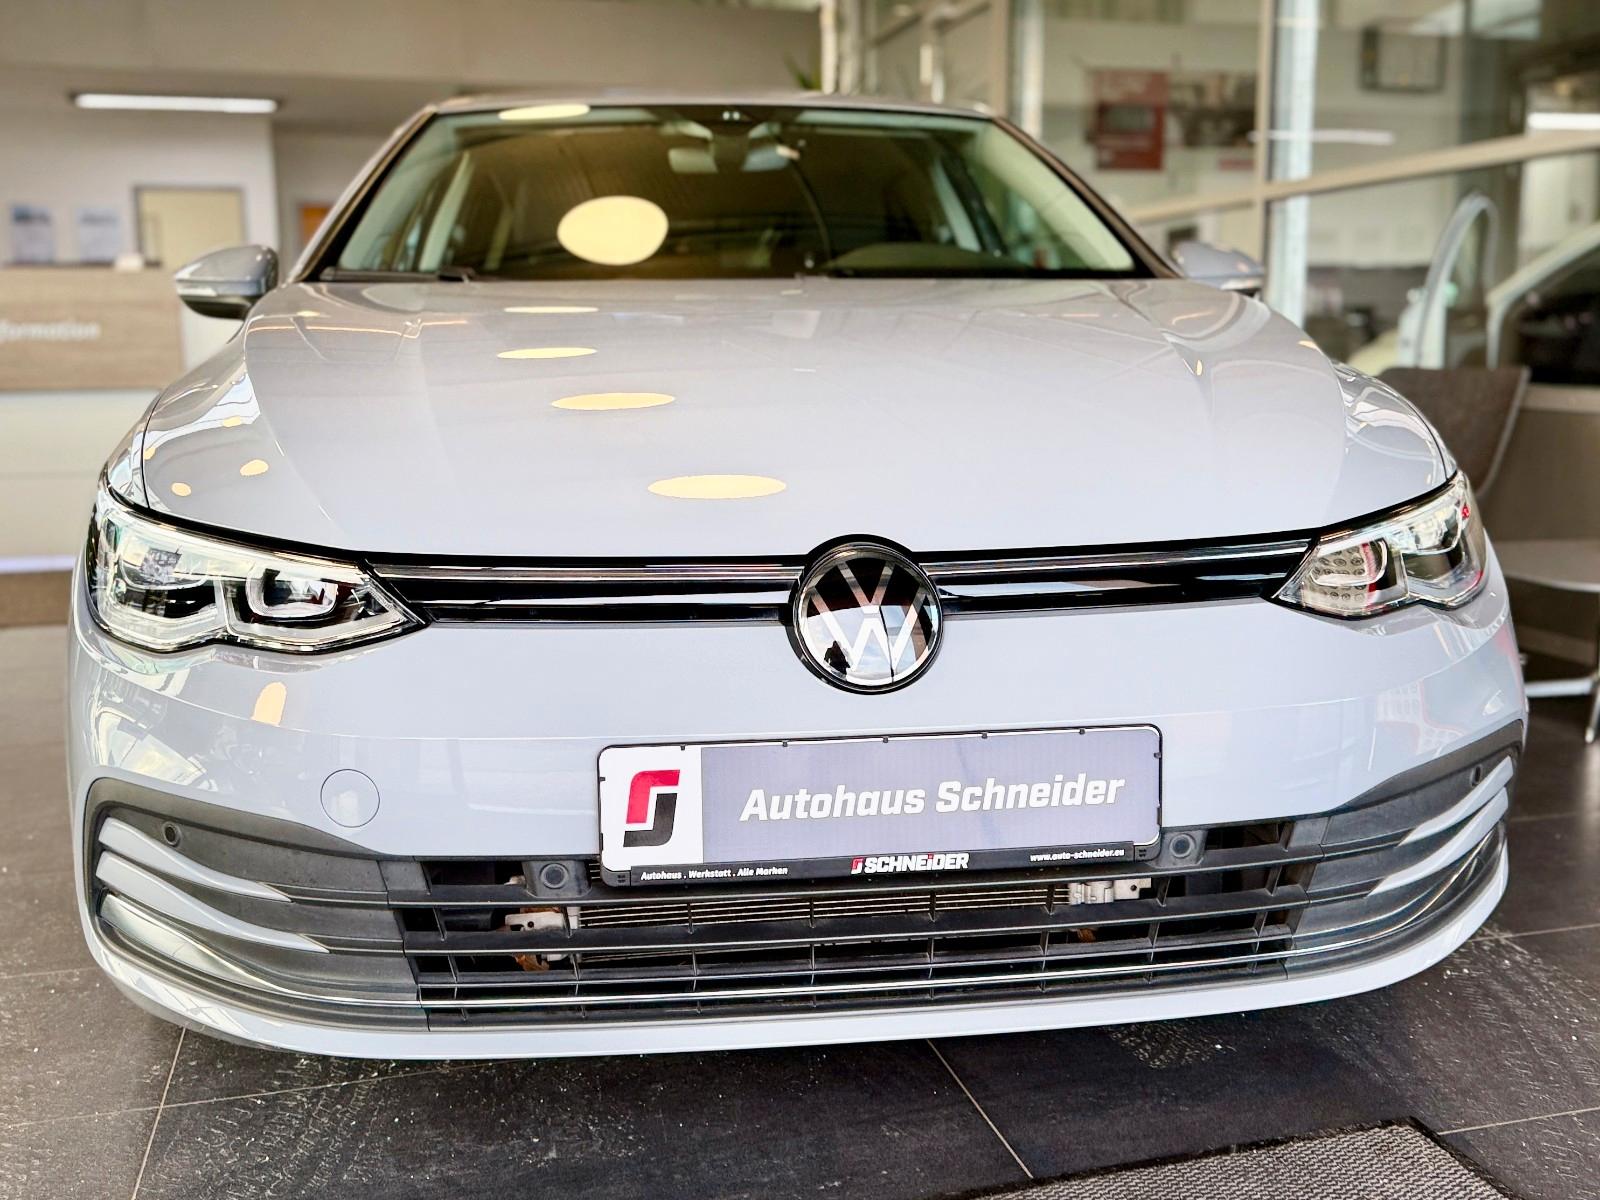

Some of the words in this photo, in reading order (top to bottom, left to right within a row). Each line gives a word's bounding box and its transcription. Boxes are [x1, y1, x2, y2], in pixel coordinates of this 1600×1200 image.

[739, 784, 926, 822] Autohaus
[935, 772, 1126, 813] Schneider
[1029, 848, 1125, 862] www.auto-schneider.eu
[640, 870, 682, 881] Autohaus
[688, 868, 732, 879] Werkstatt
[736, 867, 754, 877] Alle
[755, 866, 789, 876] Marken
